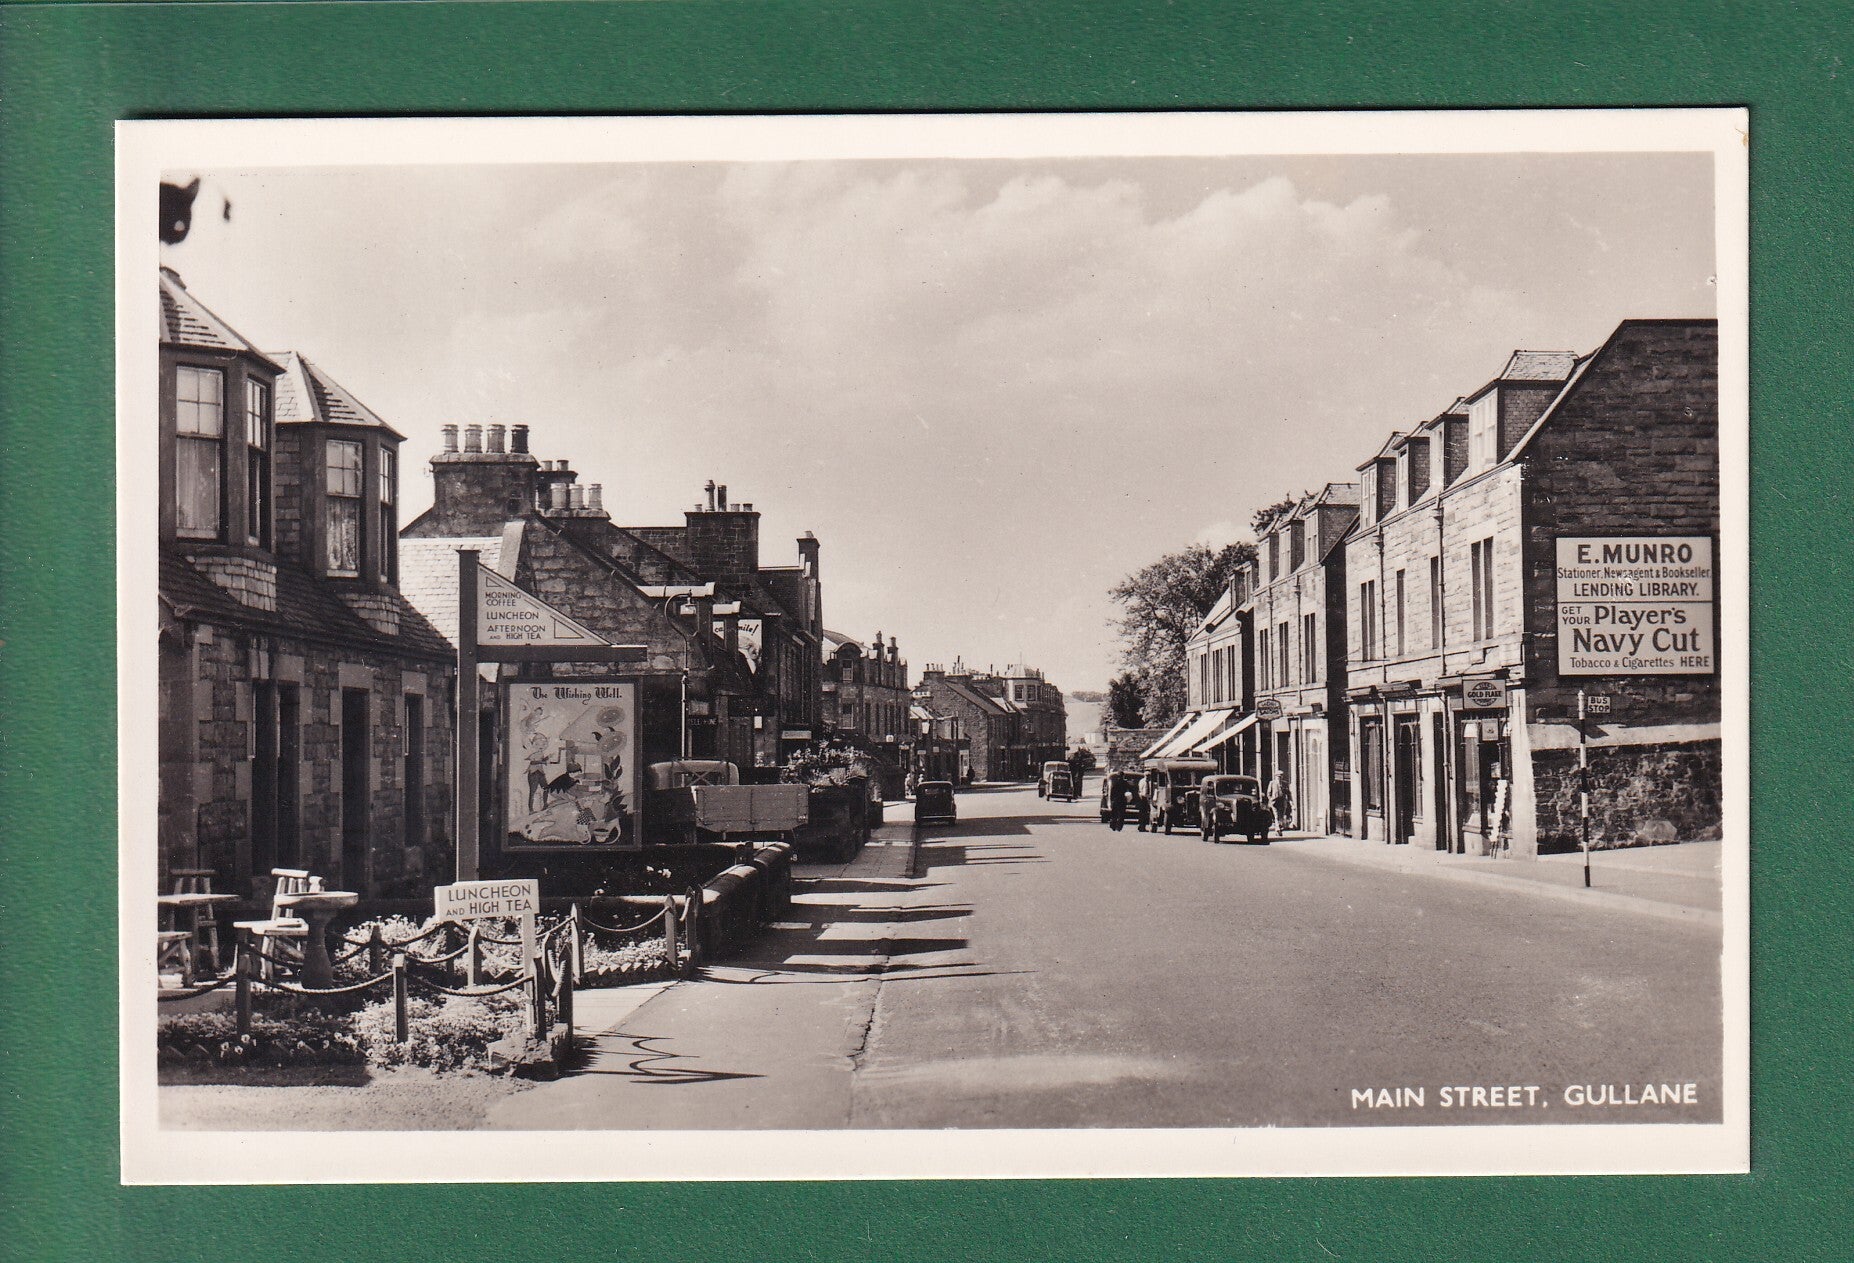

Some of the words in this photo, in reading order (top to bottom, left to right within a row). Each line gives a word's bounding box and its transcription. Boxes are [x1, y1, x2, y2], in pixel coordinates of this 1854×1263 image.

[1574, 583, 1634, 597] LENDING
[486, 611, 539, 620] LUNCHEON
[1561, 606, 1581, 615] GET
[1594, 605, 1687, 631] Player's
[1562, 616, 1590, 625] YOUR
[1572, 628, 1645, 656] Navy
[1652, 627, 1701, 652] Cut
[1570, 656, 1611, 668] Tobacco
[1614, 660, 1619, 668] &
[1622, 656, 1675, 670] Cigarettes
[1680, 656, 1710, 667] HERE
[530, 686, 548, 699] The
[553, 686, 592, 705] Wishing
[1590, 696, 1608, 704] BUS
[448, 884, 531, 901] LUNCHEON
[446, 907, 465, 916] AND
[469, 900, 499, 914] HIGH
[506, 899, 532, 912] TEA
